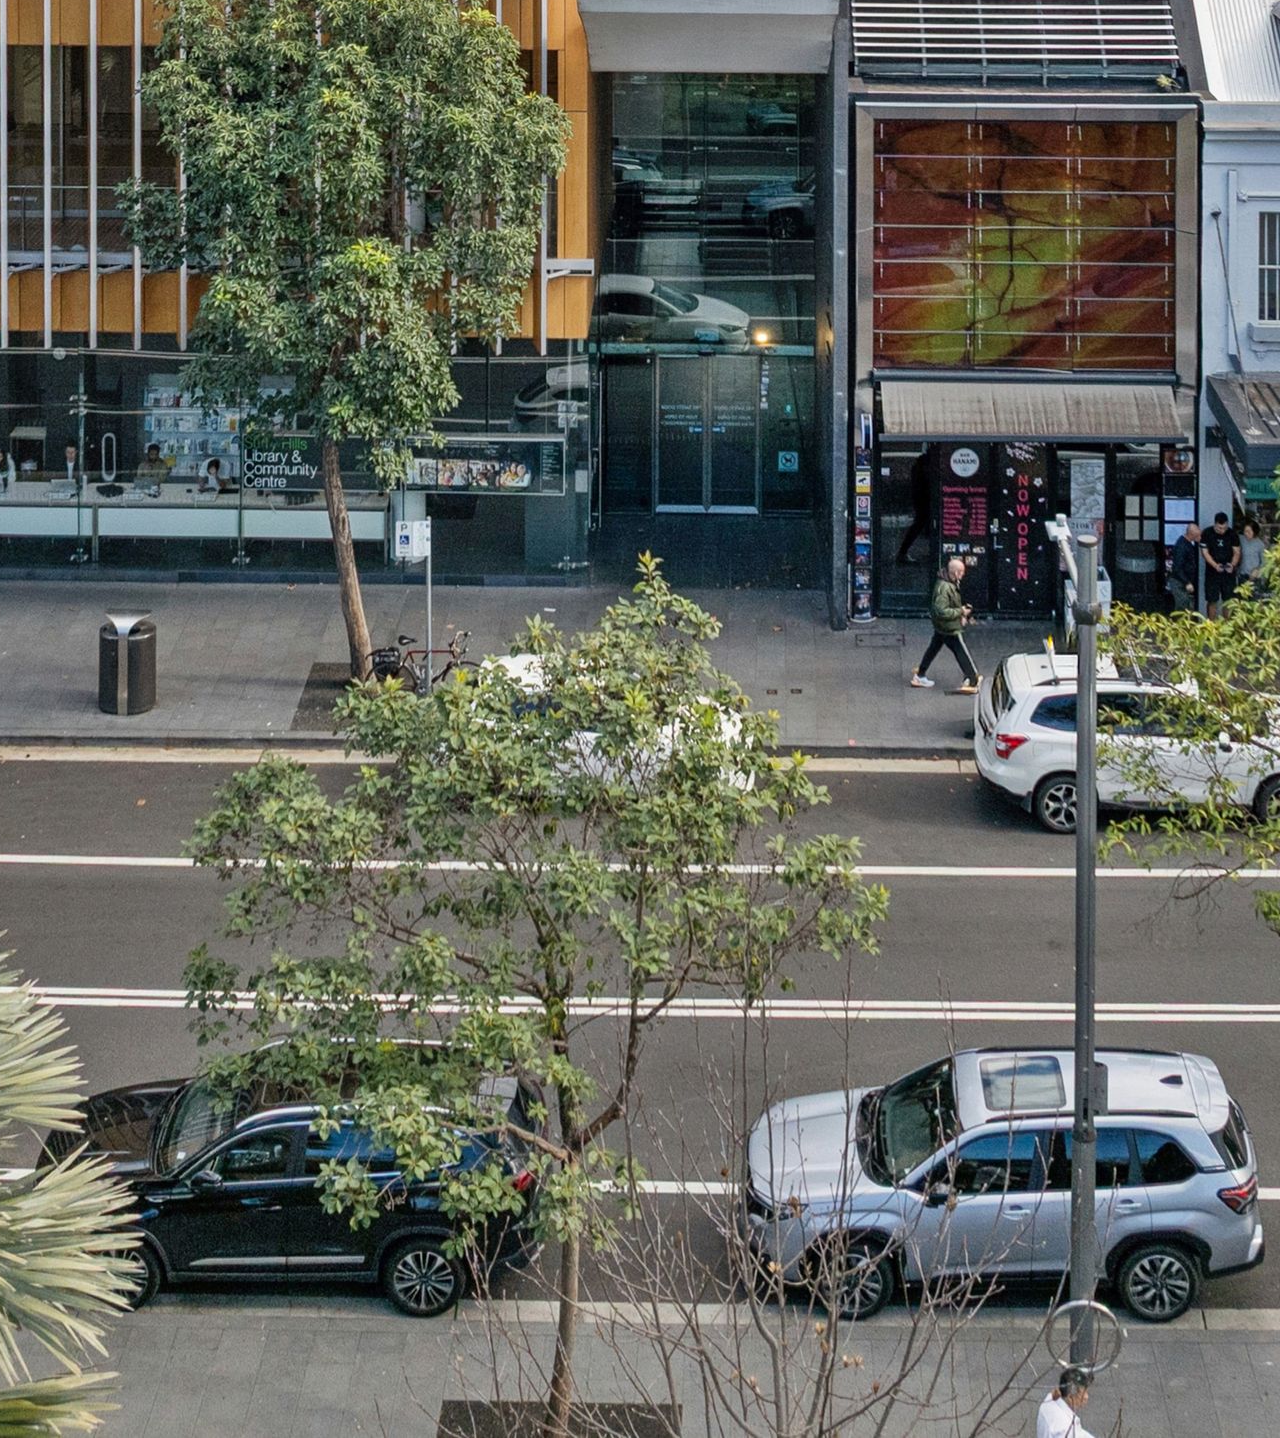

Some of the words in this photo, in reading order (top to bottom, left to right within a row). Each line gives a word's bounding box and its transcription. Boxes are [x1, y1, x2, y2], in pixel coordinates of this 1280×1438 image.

[281, 437, 308, 450] Hills
[244, 449, 288, 465] Library
[291, 450, 302, 463] &
[244, 461, 318, 479] Community
[244, 473, 287, 488] Centre
[1016, 474, 1030, 516] NOW
[1017, 523, 1029, 580] OPEN
